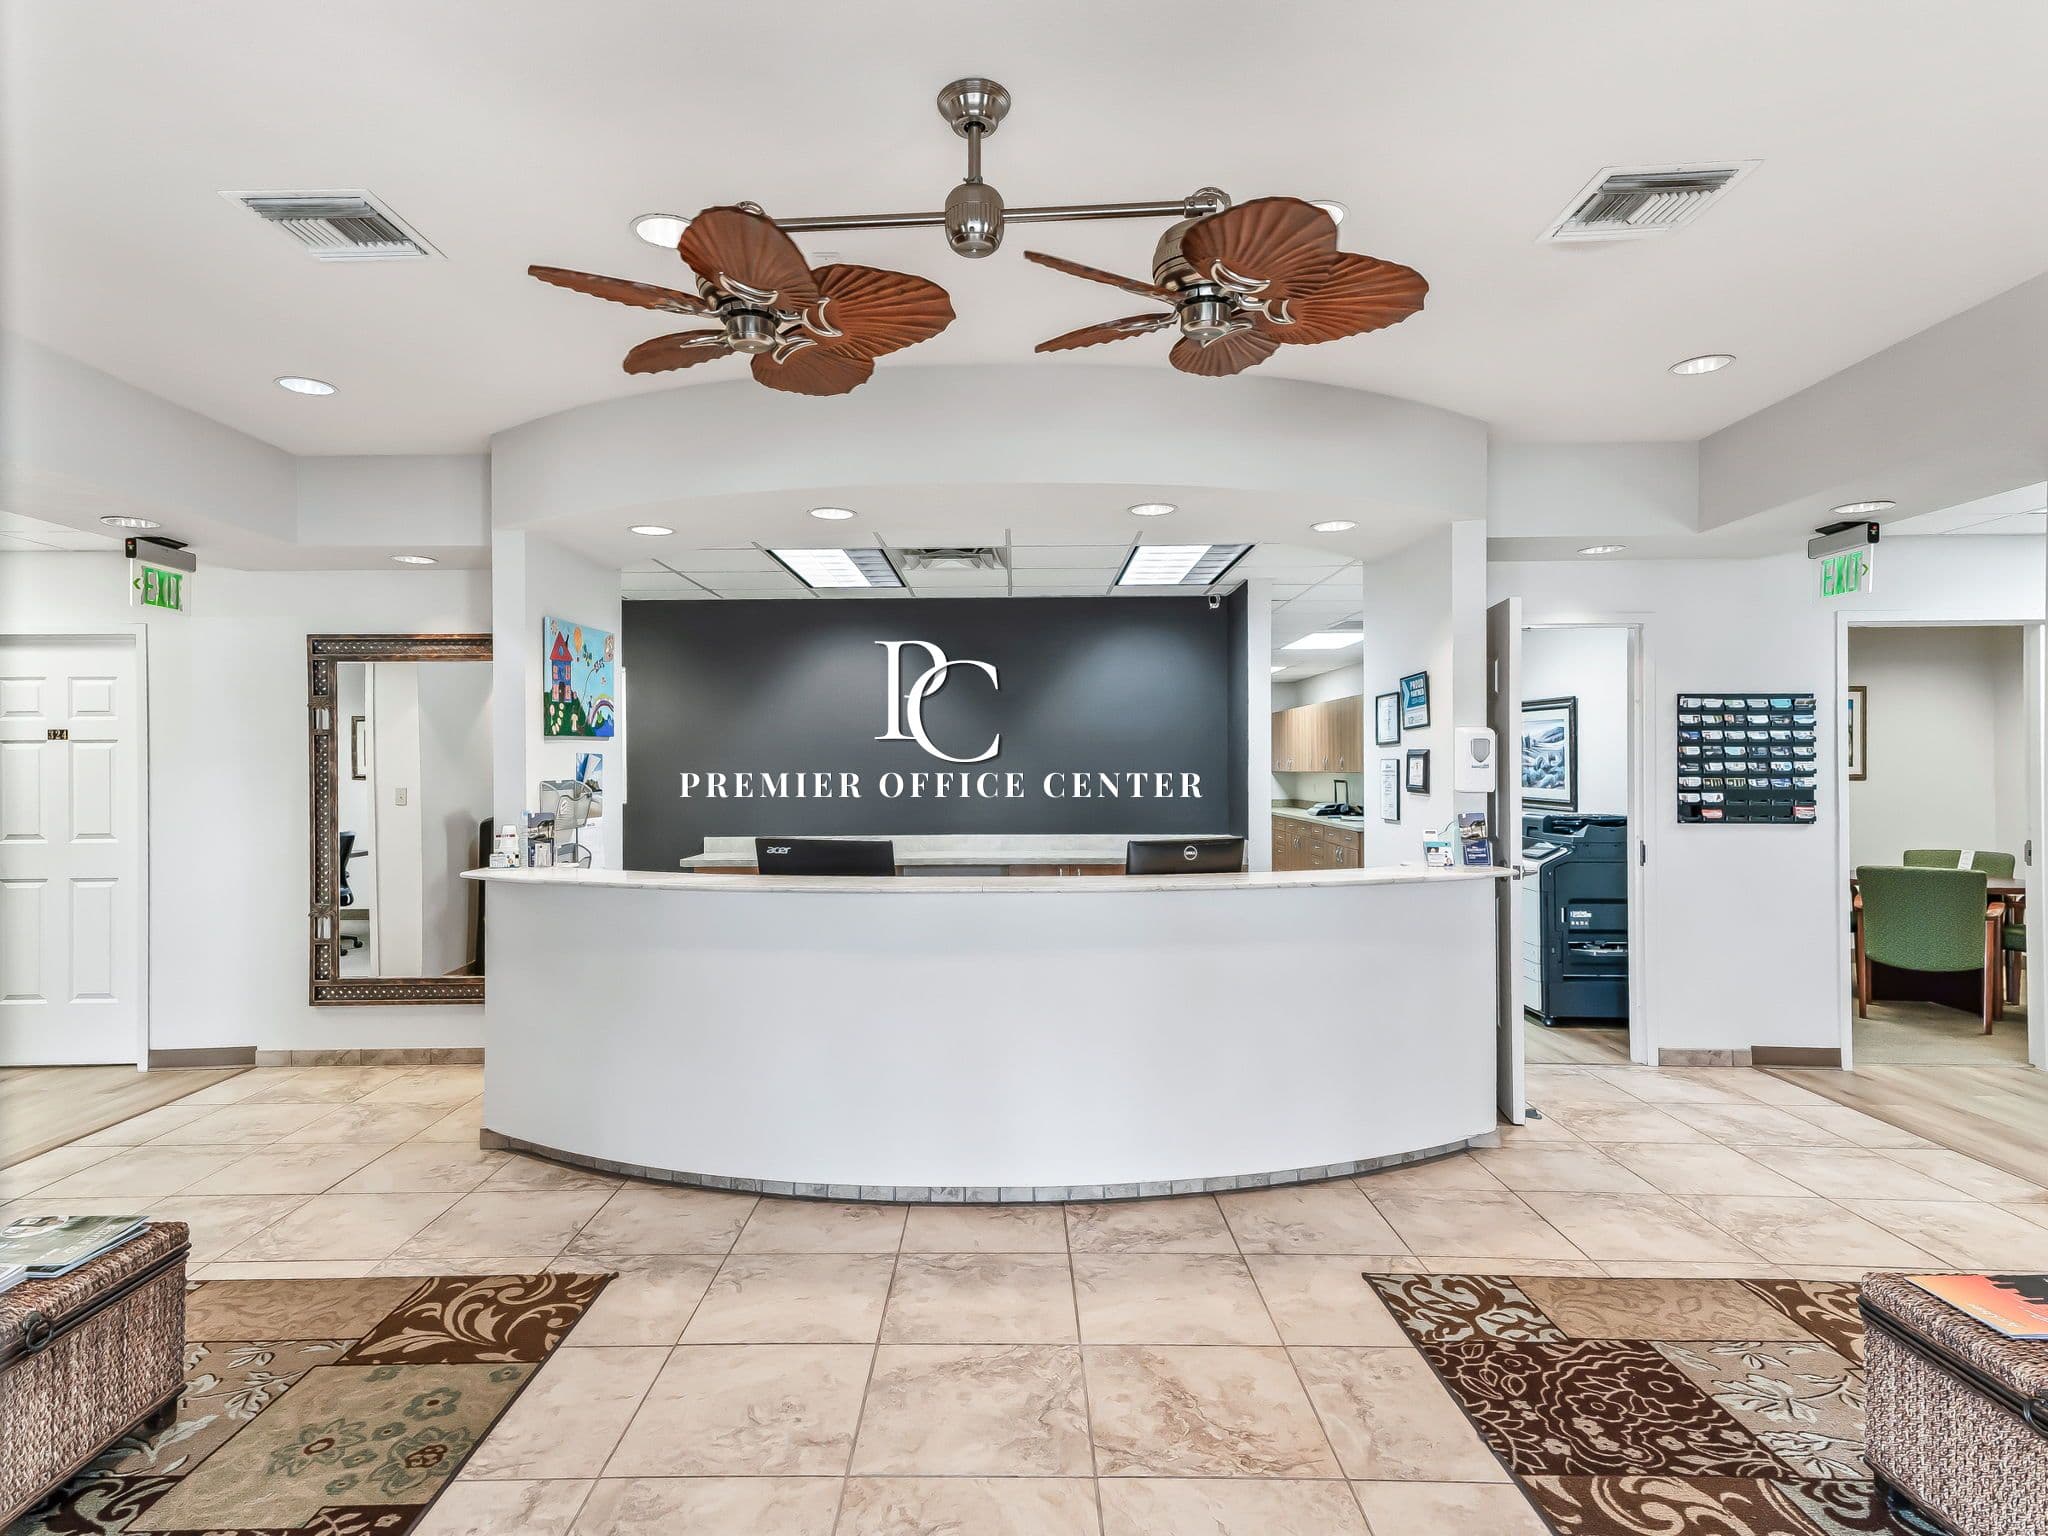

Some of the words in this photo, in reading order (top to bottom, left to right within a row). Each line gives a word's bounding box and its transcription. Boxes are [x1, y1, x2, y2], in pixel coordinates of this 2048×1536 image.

[143, 566, 183, 611] EXIT
[1822, 550, 1864, 597] EXIT
[679, 772, 861, 798] PREMIER
[878, 772, 1025, 798] OFFICE
[1043, 772, 1203, 798] CENTER
[766, 846, 791, 854] acer
